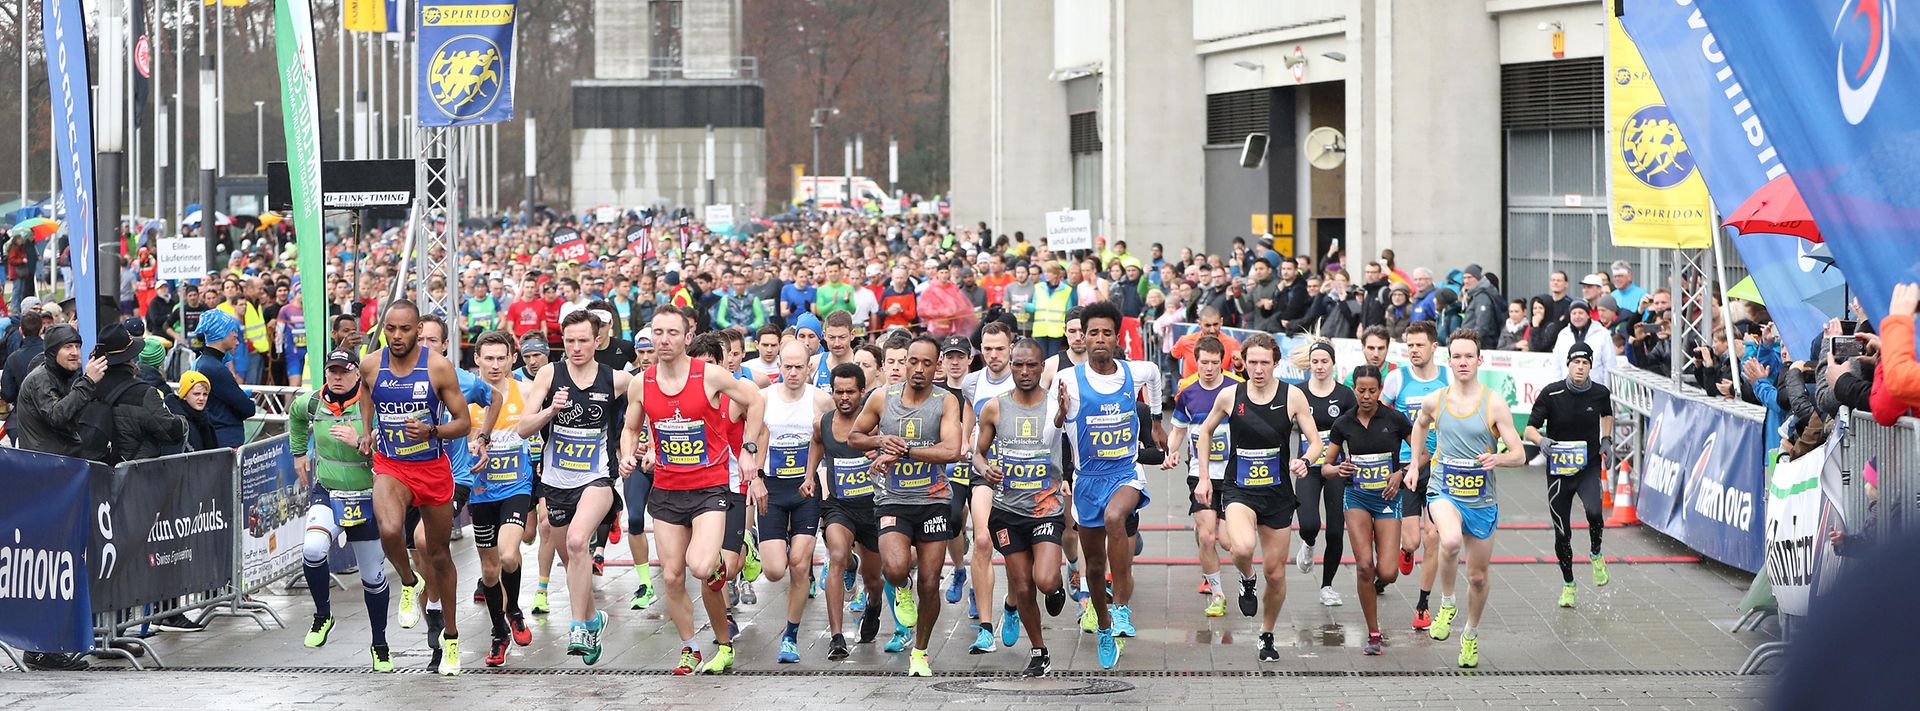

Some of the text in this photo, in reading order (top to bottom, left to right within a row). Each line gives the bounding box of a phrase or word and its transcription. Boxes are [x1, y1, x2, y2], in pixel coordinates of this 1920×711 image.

[443, 8, 511, 19] SPIRIDON
[1637, 207, 1704, 218] SPIRIDON
[172, 242, 190, 250] Elite-
[161, 254, 202, 262] Läuferinnen
[163, 265, 201, 273] und Läufer
[379, 401, 428, 413] SCHOTT
[557, 403, 584, 425] Spaß
[384, 429, 405, 443] 71
[1090, 427, 1132, 445] 7075
[555, 440, 596, 458] 7477
[660, 440, 705, 455] 3982
[785, 455, 796, 467] 5
[1551, 453, 1584, 465] 7415
[894, 462, 932, 476] 7077
[1005, 463, 1047, 478] 7078
[1249, 465, 1269, 478] 36
[1355, 465, 1390, 479] 7375
[1445, 473, 1484, 488] 3365
[343, 505, 362, 519] 34
